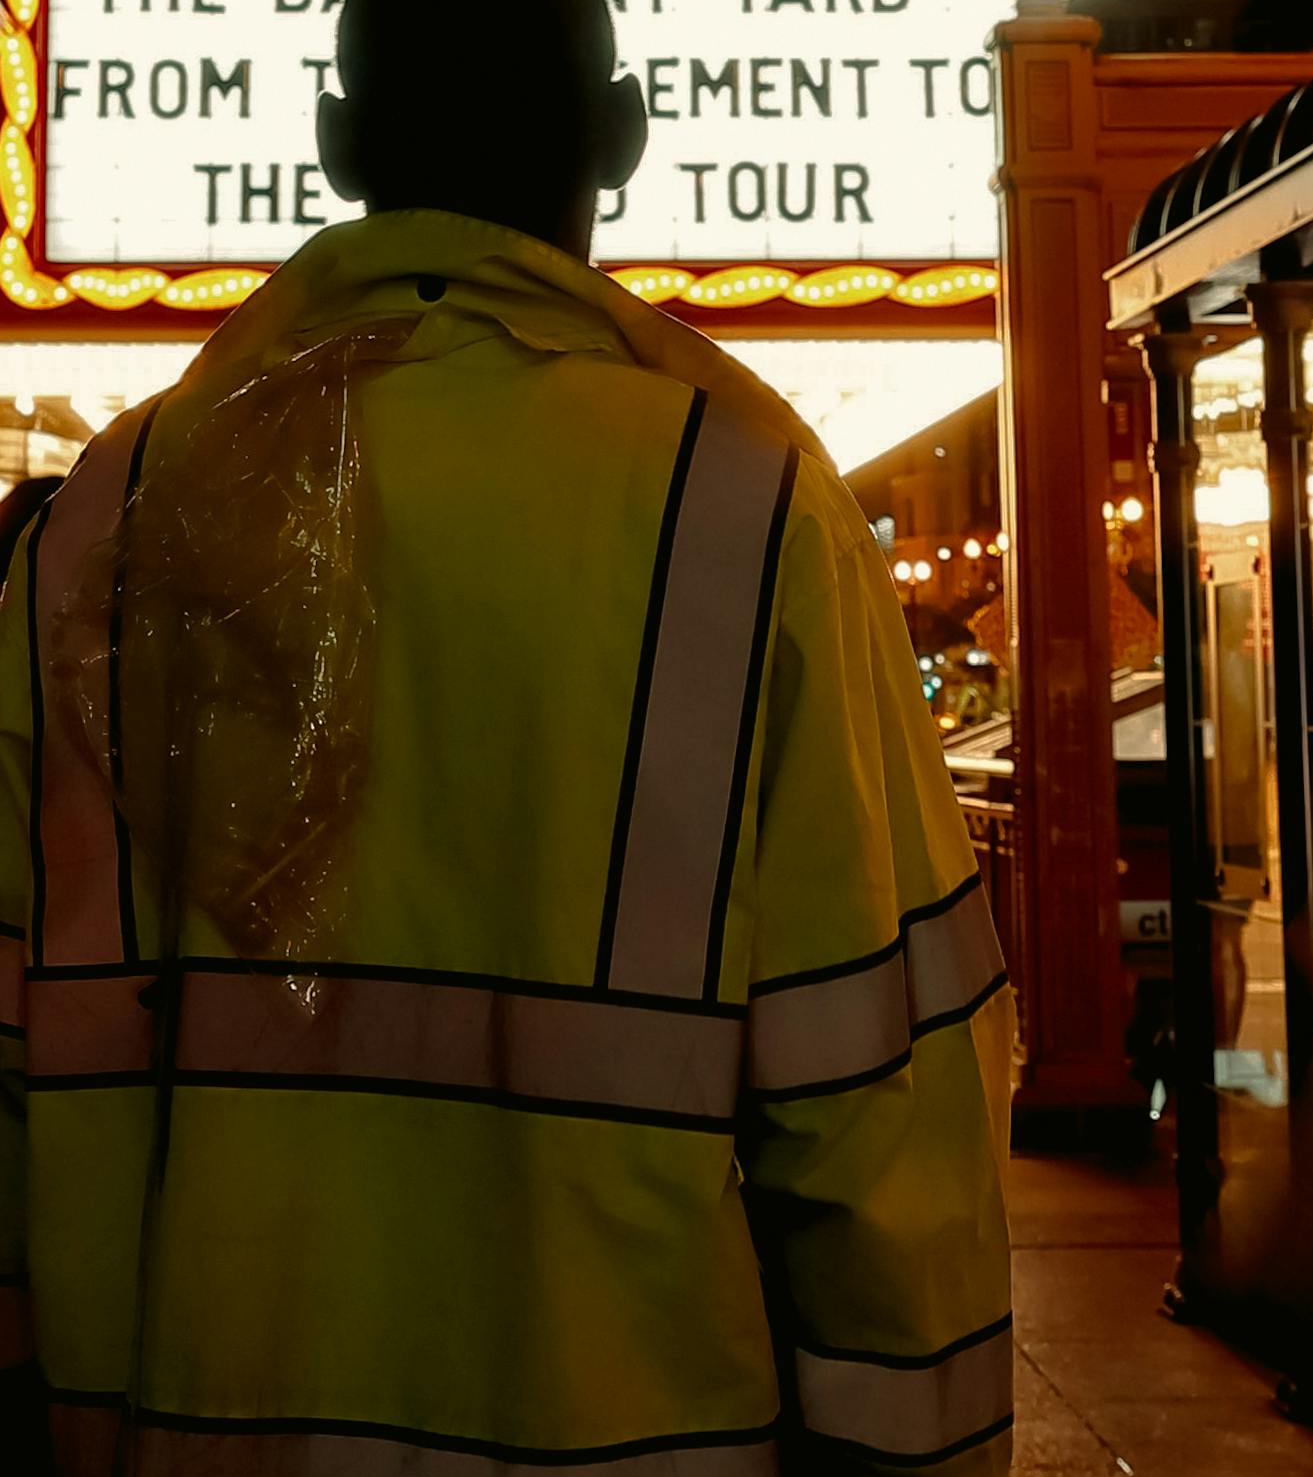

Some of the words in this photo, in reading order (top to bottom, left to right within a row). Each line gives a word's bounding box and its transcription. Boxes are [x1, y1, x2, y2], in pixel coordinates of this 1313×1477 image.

[53, 57, 253, 120] FROM
[619, 57, 881, 119] EMENT
[908, 56, 991, 119] TO
[193, 162, 328, 226] THE
[675, 161, 875, 225] TOUR
[1138, 909, 1168, 937] ct
